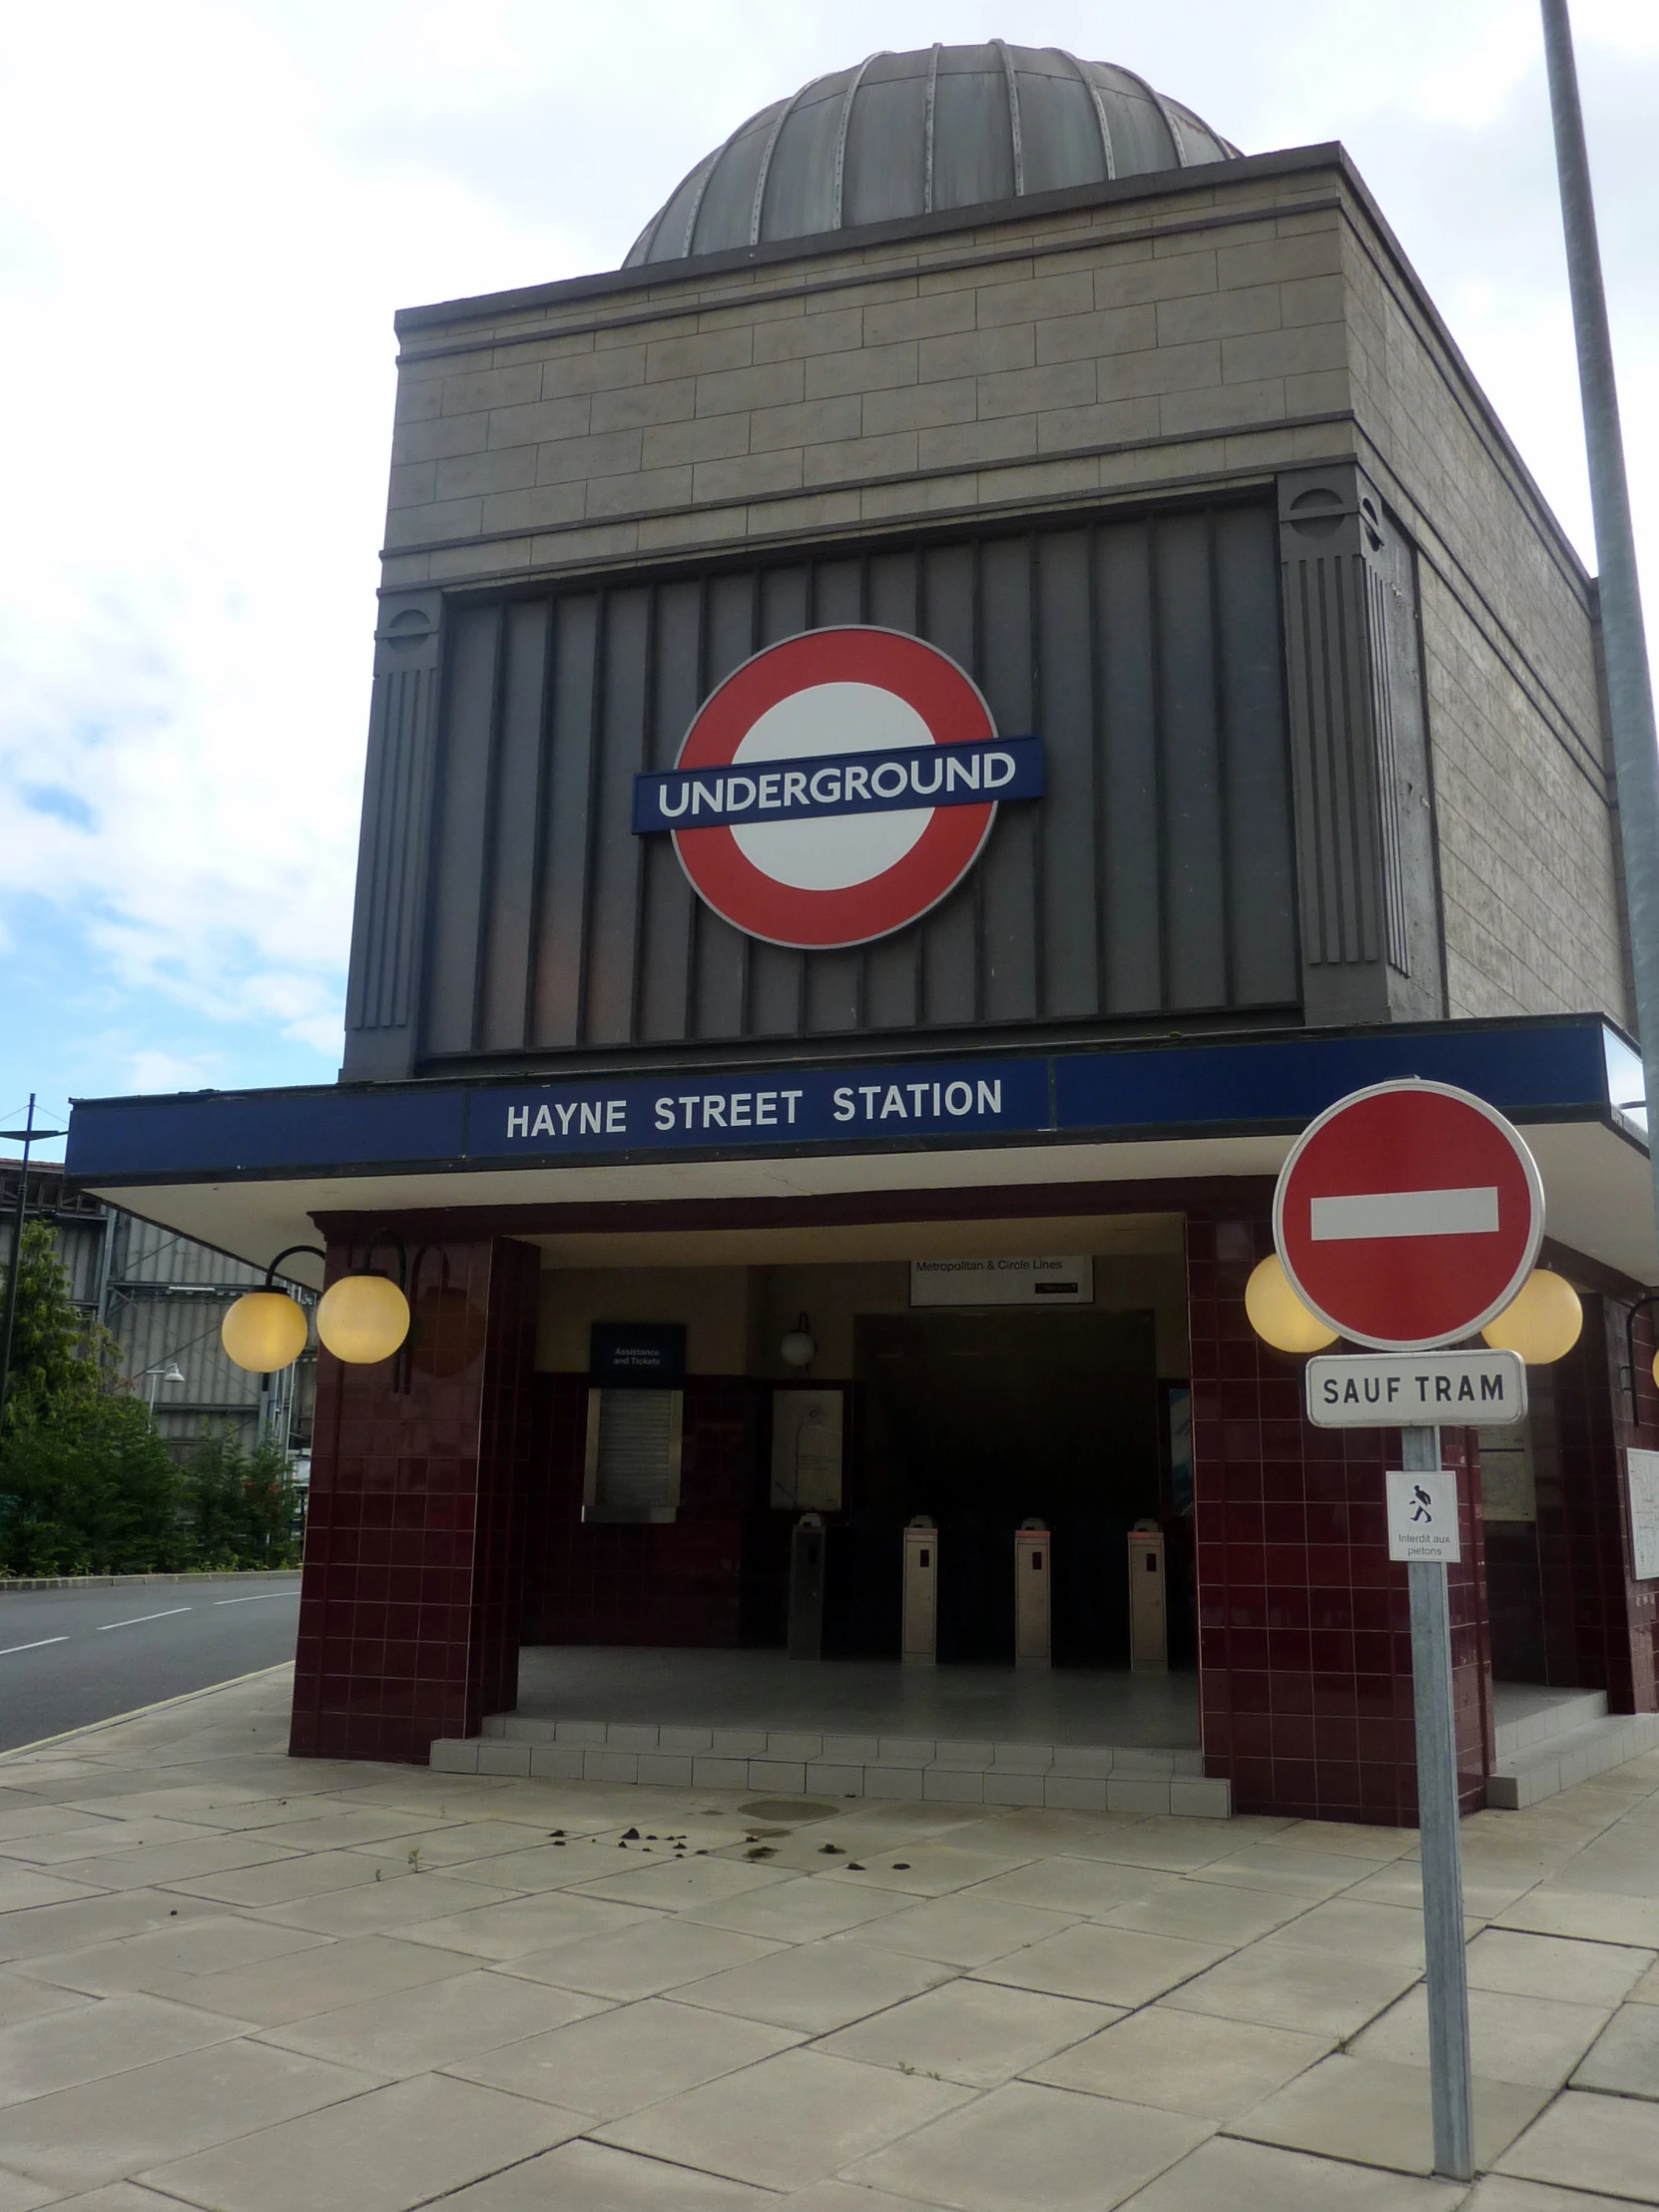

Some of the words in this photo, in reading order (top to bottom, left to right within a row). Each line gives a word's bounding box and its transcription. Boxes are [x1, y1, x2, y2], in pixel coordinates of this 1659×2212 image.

[658, 751, 1017, 818] UNDERGROUND
[506, 1099, 628, 1138] HAYNE
[654, 1090, 804, 1131] STREET
[832, 1079, 1002, 1122] STATION
[915, 1260, 984, 1273] Metropolitan
[986, 1260, 995, 1271] &
[998, 1259, 1030, 1271] Circle
[1032, 1259, 1063, 1271] Lines
[615, 1348, 661, 1357] Assistance
[1323, 1377, 1400, 1404] SAUF
[1414, 1374, 1504, 1402] TRAM
[1398, 1533, 1430, 1543] Interdit
